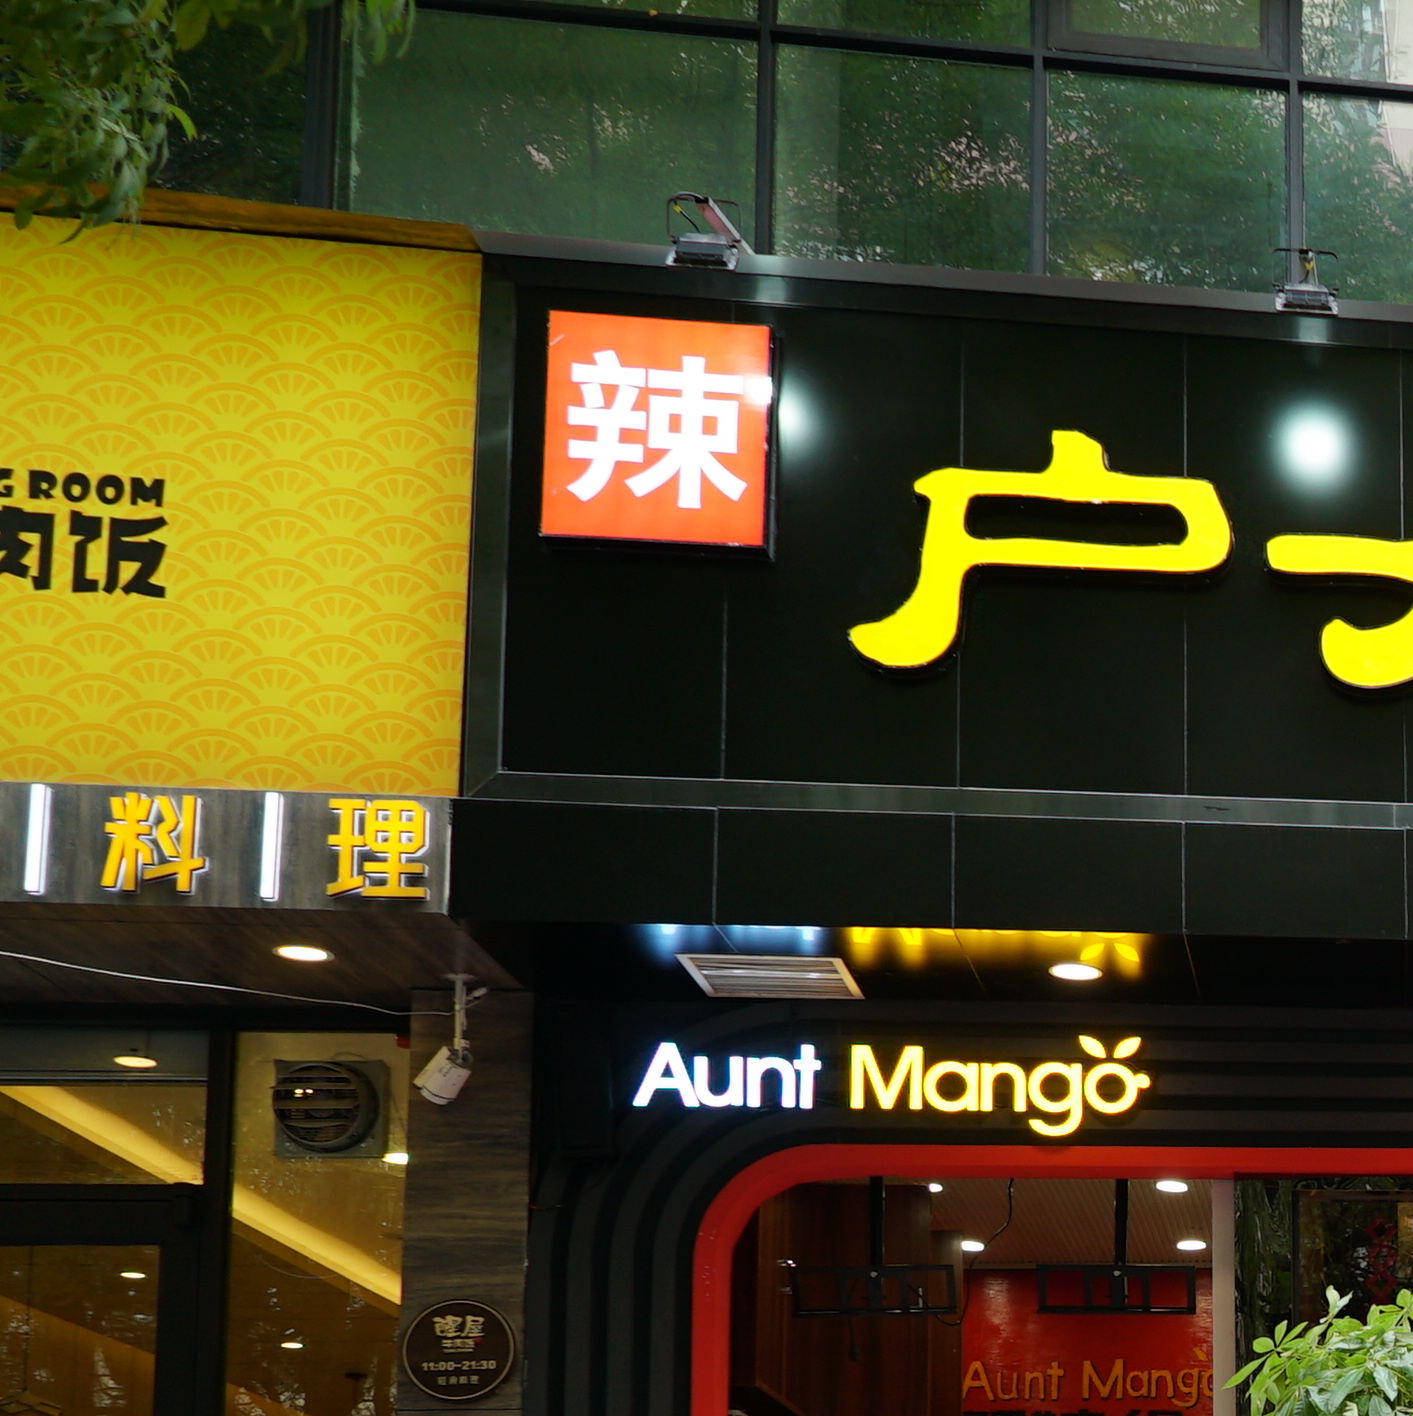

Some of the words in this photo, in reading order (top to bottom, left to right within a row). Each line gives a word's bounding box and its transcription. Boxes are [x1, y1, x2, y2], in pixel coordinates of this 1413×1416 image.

[567, 349, 748, 509] 辣
[28, 469, 165, 507] ROOM
[632, 1042, 821, 1109] Aunt
[849, 1038, 1150, 1137] Mango
[962, 1360, 1065, 1401] Aunt
